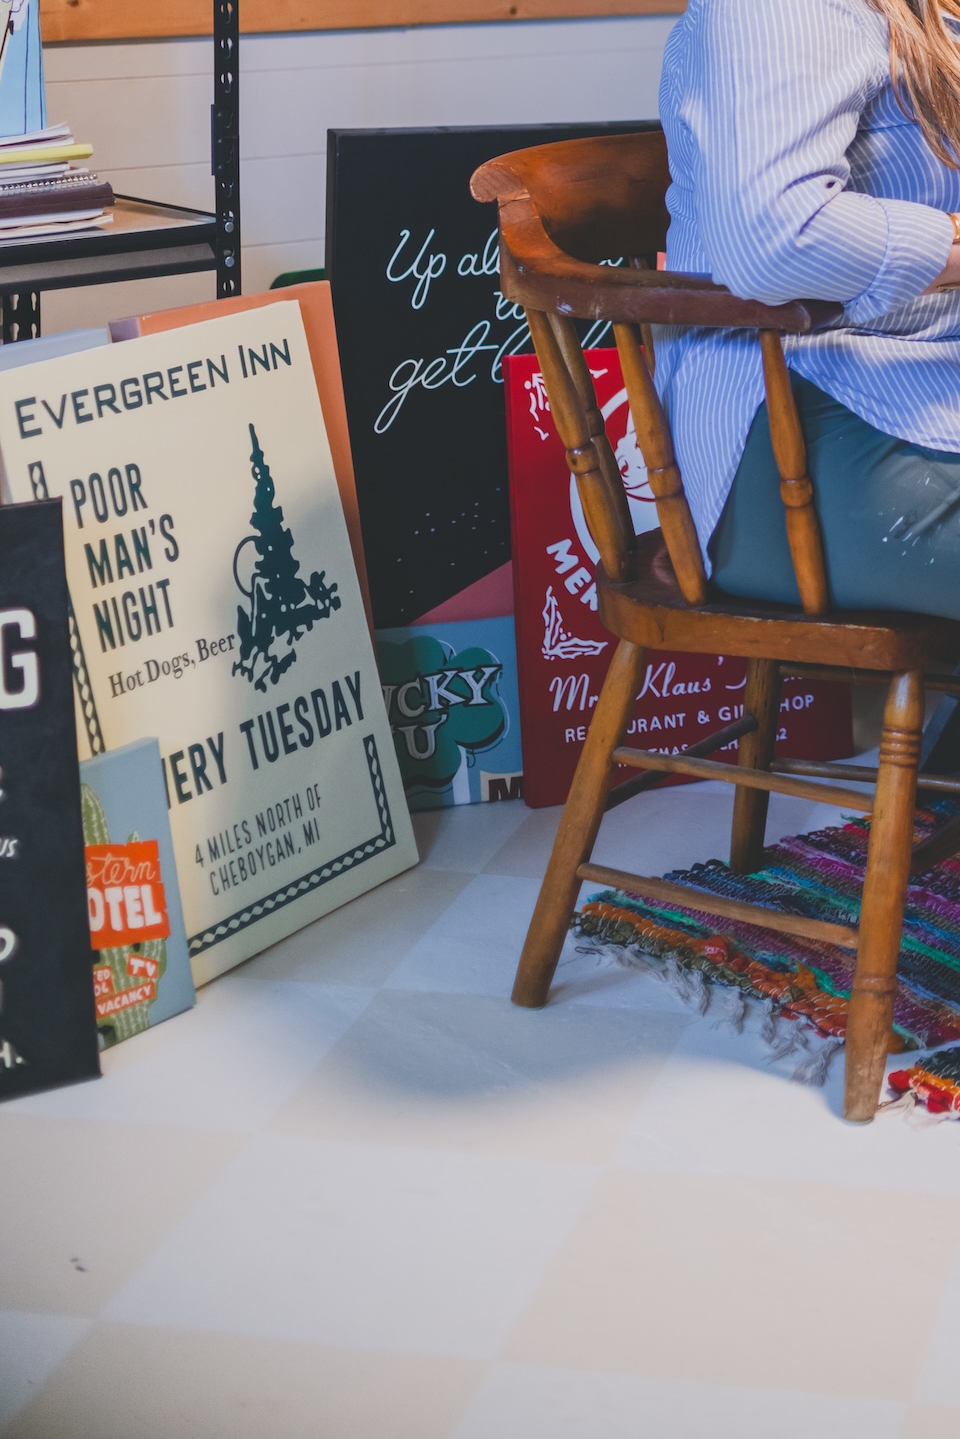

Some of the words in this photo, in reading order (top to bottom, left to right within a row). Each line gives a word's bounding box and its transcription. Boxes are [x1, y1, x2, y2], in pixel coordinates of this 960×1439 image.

[385, 228, 447, 310] Up
[14, 354, 230, 440] EVERGREEN
[238, 338, 293, 379] INN
[374, 319, 500, 434] get
[69, 463, 149, 529] POOR
[84, 513, 180, 590] MAN'S
[92, 578, 175, 654] NIGHT
[108, 669, 145, 698] Hot
[145, 648, 197, 685] Dogs,
[195, 633, 236, 664] Beer
[636, 656, 724, 701] Klaus'
[239, 670, 365, 771] TUESDAY
[697, 710, 710, 724] &
[194, 844, 205, 868] 4
[207, 820, 251, 863] MILES
[255, 793, 303, 838] NORTH
[305, 783, 322, 811] OF
[209, 832, 302, 896] CHEBOYGAN,
[303, 817, 321, 847] MI
[97, 984, 152, 1015] VACANCY
[129, 957, 156, 978] TV
